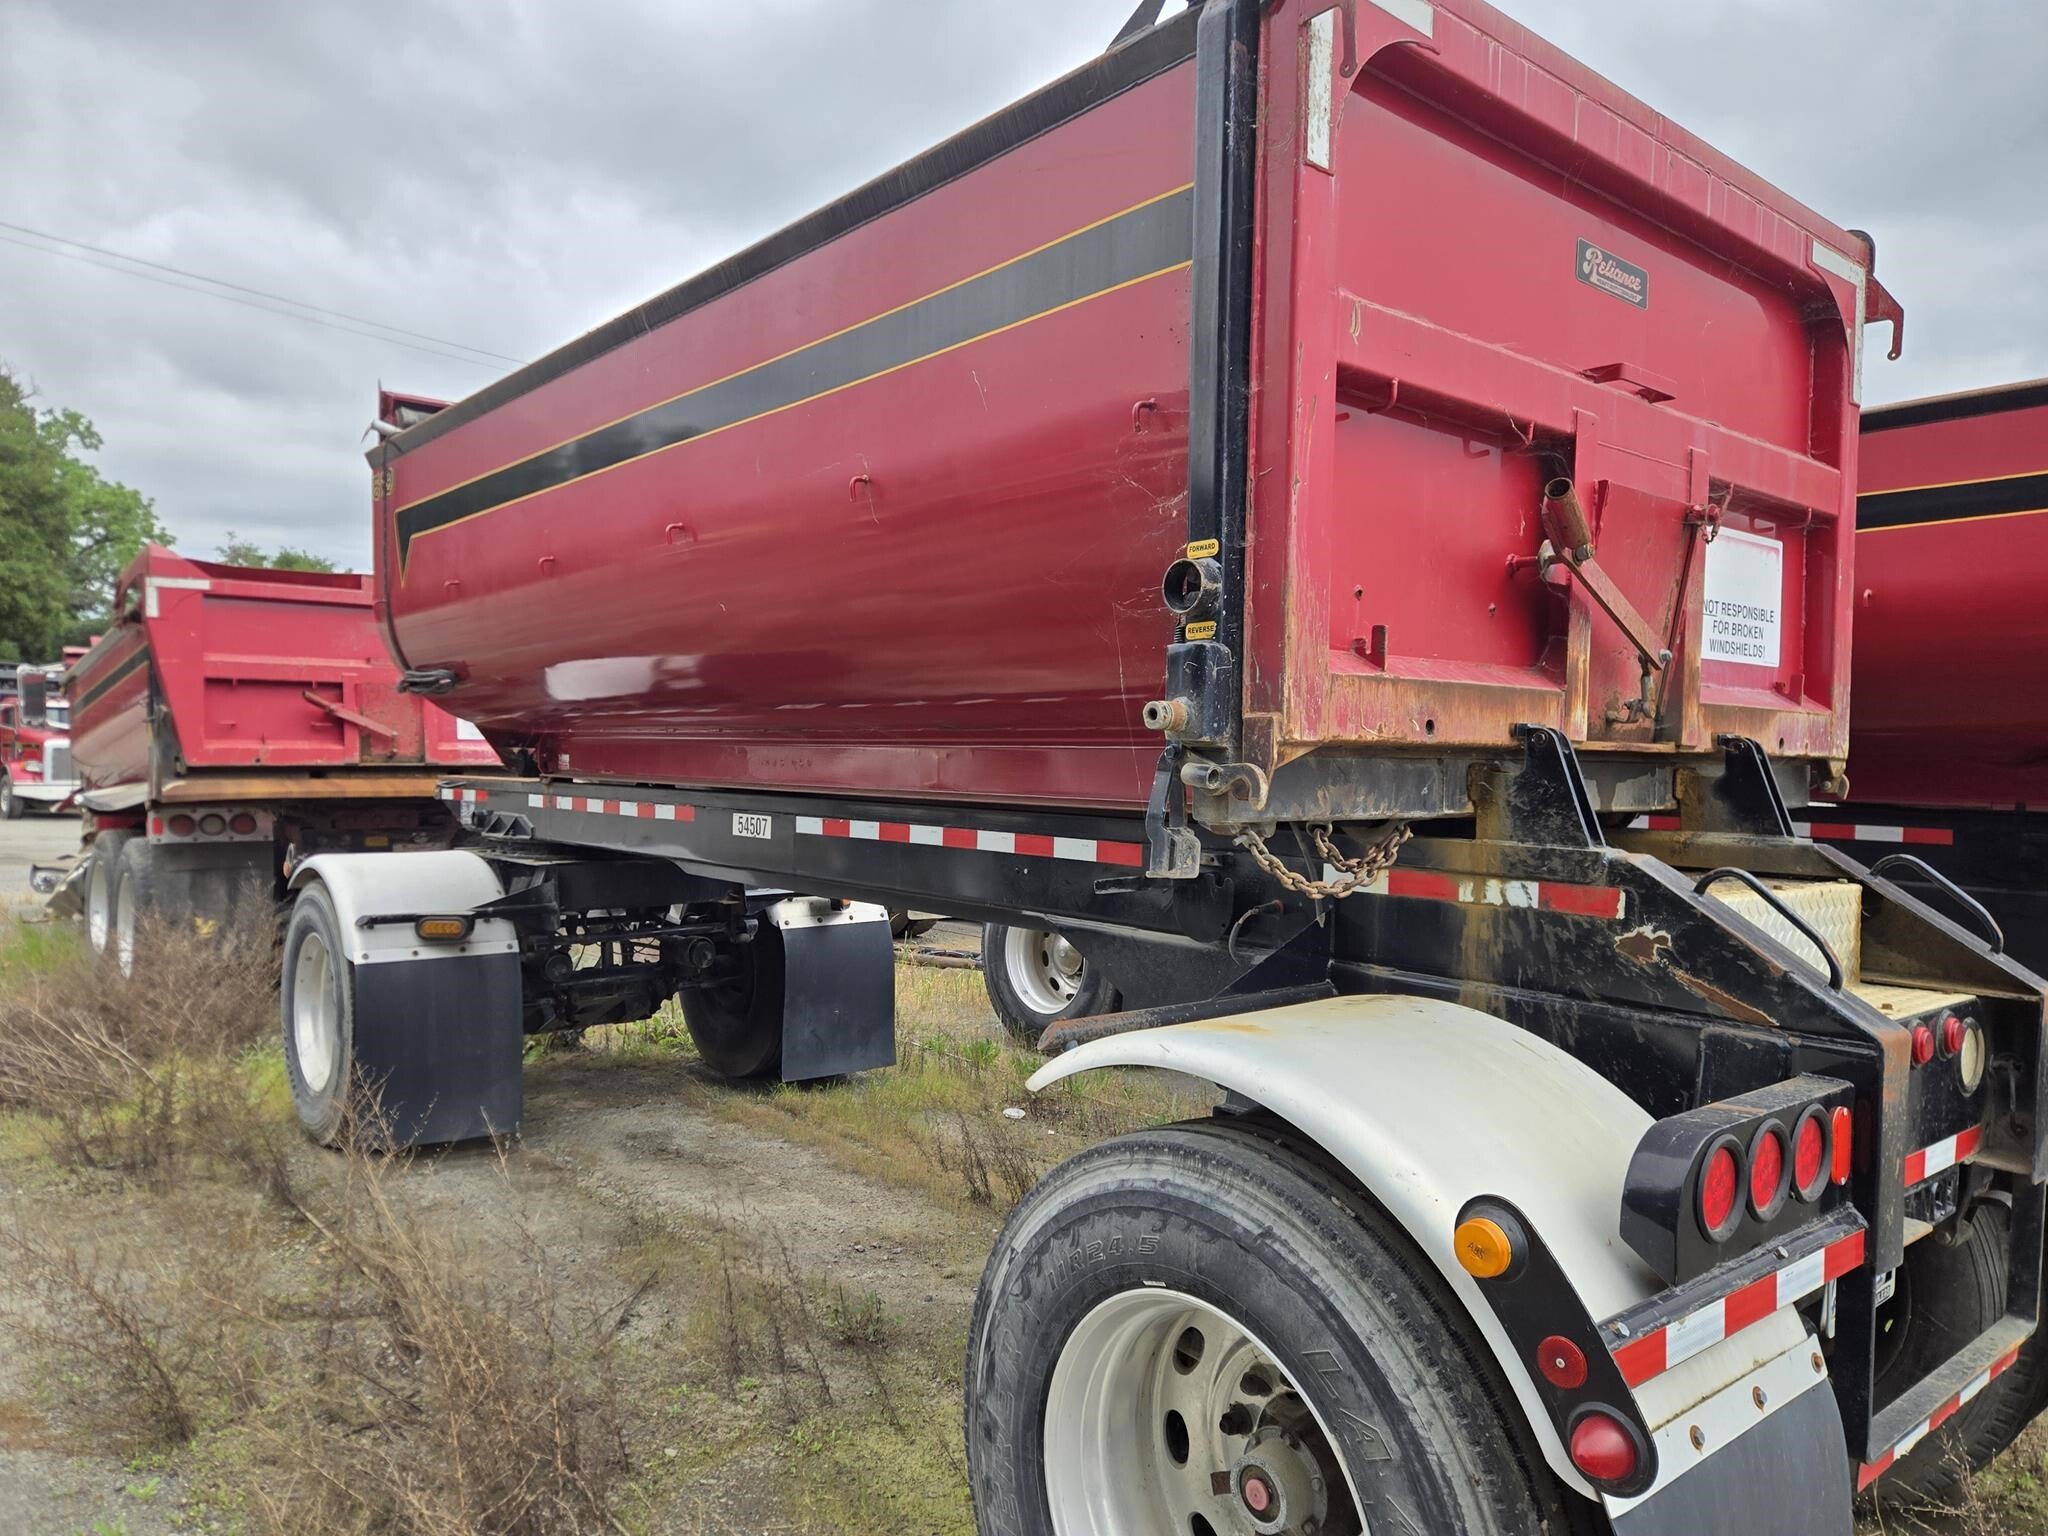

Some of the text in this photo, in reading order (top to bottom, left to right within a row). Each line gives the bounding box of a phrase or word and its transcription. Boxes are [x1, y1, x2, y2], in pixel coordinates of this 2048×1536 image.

[1582, 247, 1642, 291] Reliance
[1189, 543, 1216, 553] FORWARD
[1721, 602, 1774, 623] RESPONSIBLE
[1188, 625, 1214, 634] REVERSE
[1712, 620, 1764, 640] FOR BROKEN
[1709, 637, 1766, 659] WINDSHIELDS!
[738, 815, 768, 837] 54507
